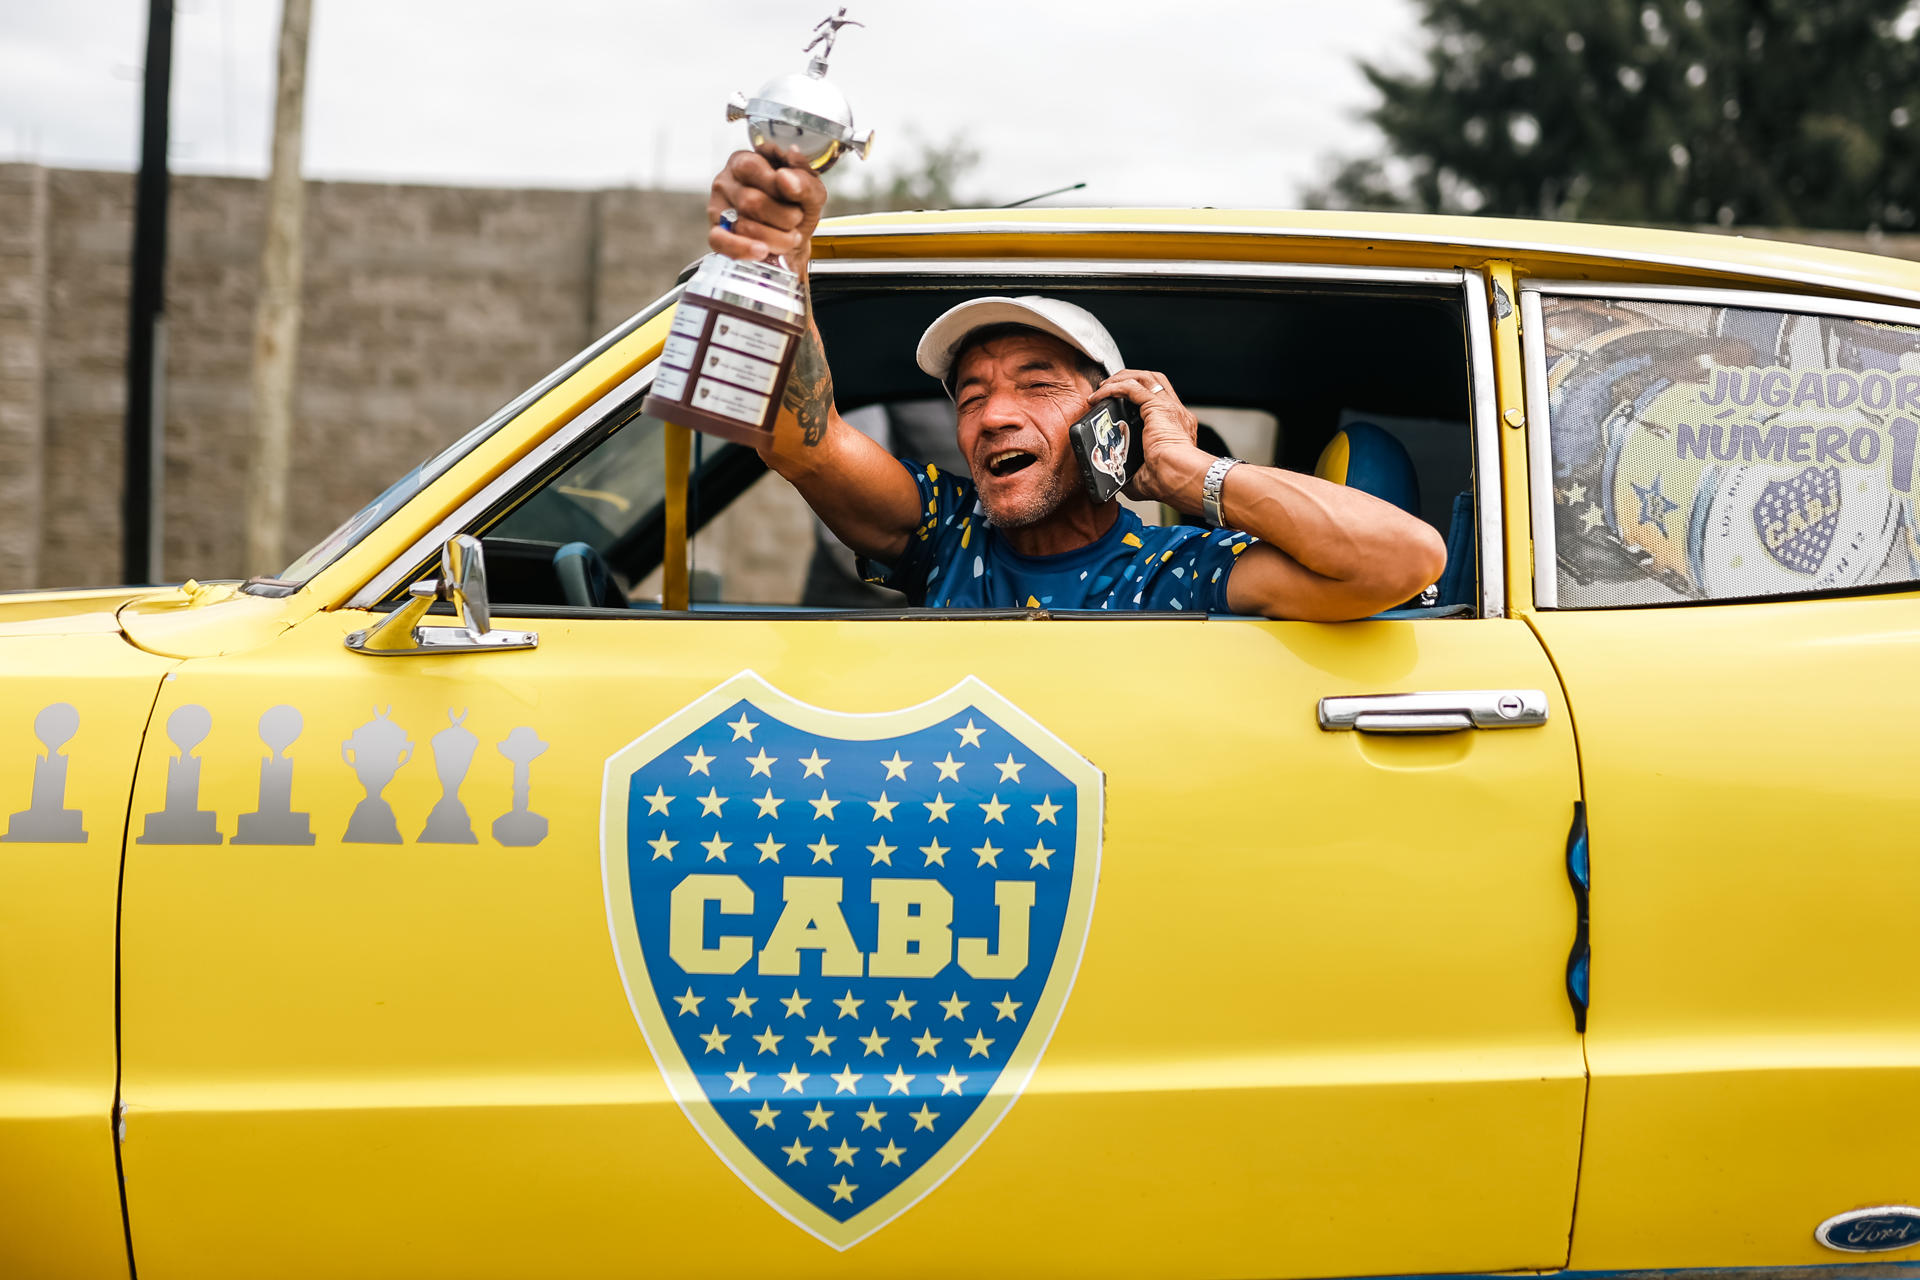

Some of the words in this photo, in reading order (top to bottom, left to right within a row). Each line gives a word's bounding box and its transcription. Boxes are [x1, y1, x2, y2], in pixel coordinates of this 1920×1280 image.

[1700, 370, 1920, 412] JUGADOR
[1676, 408, 1880, 465] NÚMERO
[1765, 486, 1839, 550] CABJ
[669, 873, 1036, 980] CABJ
[1847, 1219, 1912, 1243] Ford
